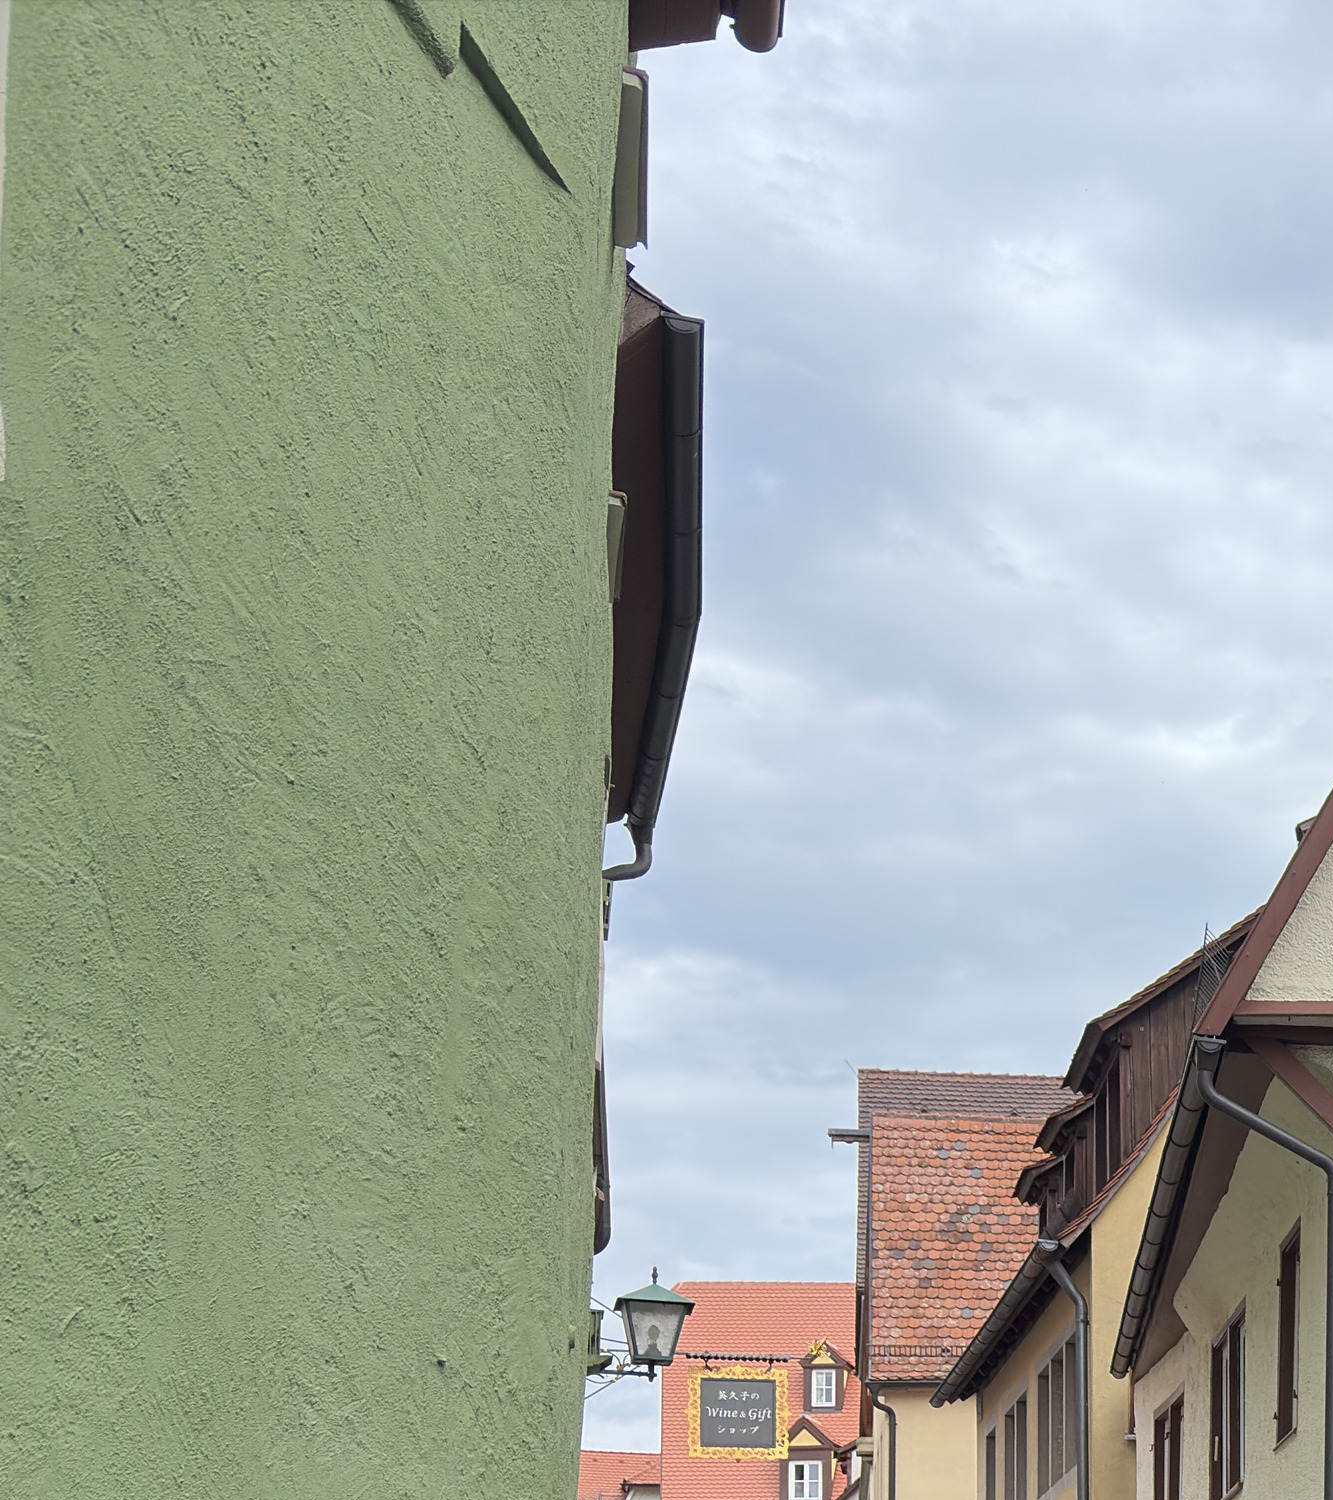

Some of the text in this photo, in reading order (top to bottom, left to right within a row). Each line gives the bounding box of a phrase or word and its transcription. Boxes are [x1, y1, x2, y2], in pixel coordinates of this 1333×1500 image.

[705, 1405, 772, 1422] Wine & Gift
[717, 1425, 760, 1434] ショップ
